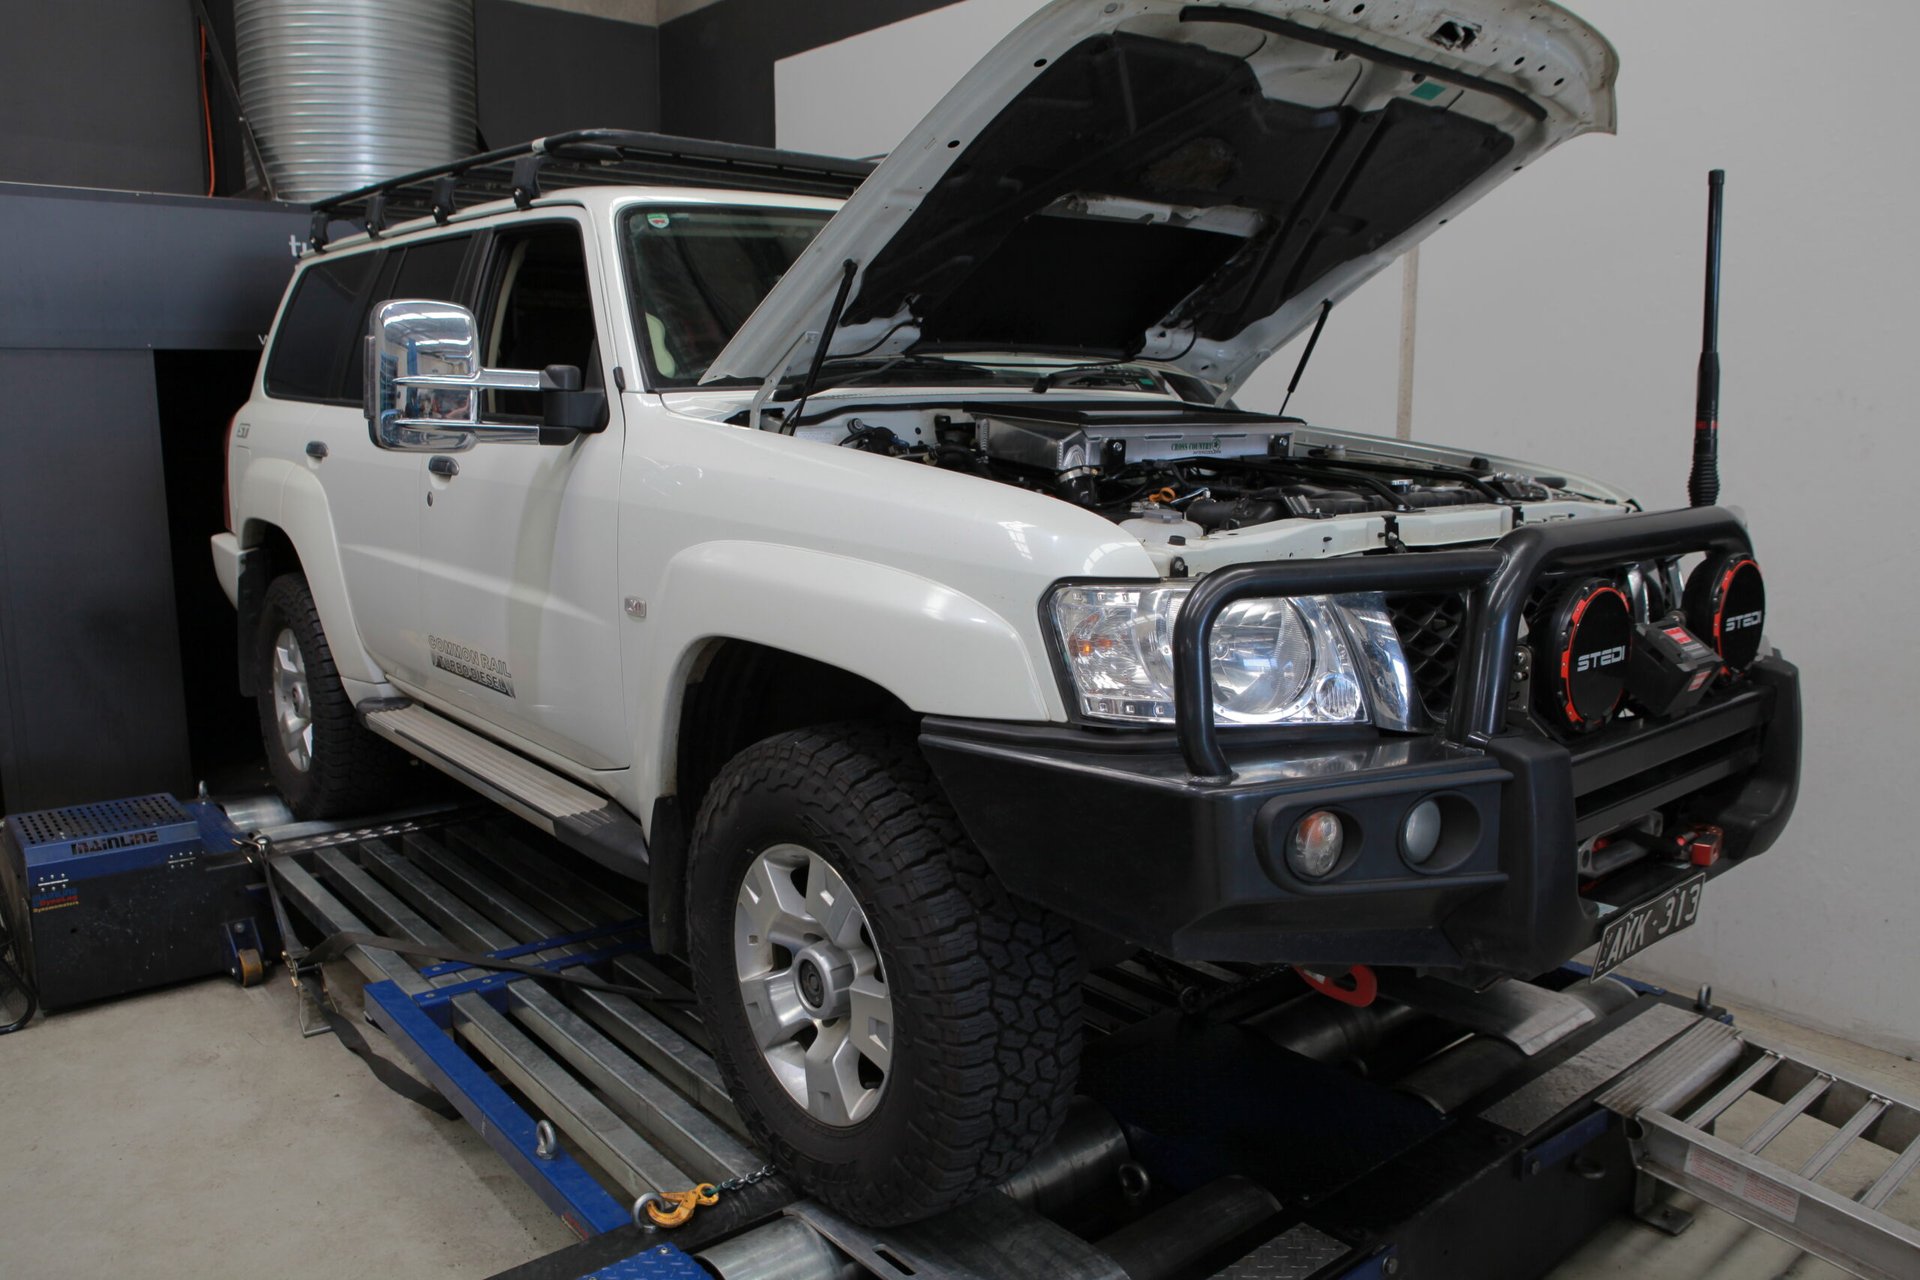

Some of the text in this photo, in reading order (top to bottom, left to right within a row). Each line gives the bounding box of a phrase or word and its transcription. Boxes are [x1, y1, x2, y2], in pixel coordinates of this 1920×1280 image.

[1725, 611, 1762, 632] STEDI
[428, 634, 512, 679] COMMON RAIL
[1577, 645, 1626, 672] STEDI
[470, 667, 507, 692] DIESEL
